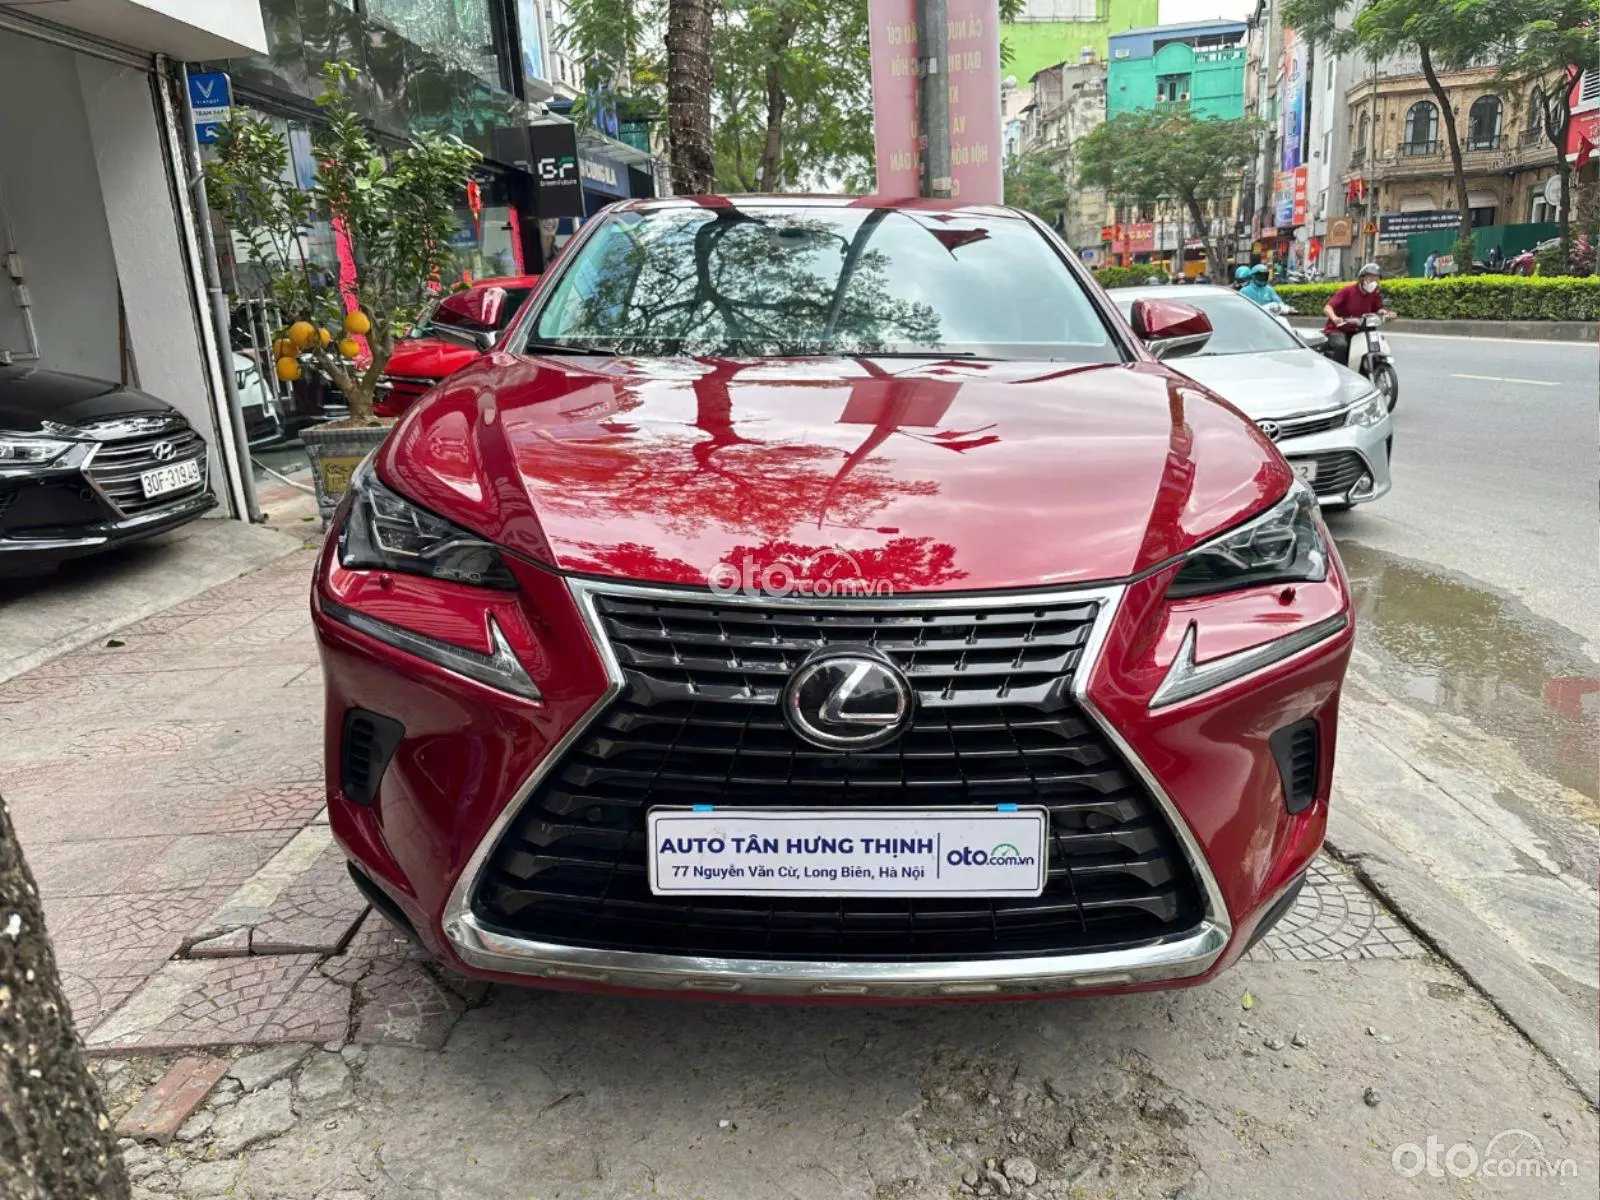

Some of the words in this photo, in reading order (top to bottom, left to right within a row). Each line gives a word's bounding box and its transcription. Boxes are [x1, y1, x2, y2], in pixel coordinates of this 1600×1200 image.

[659, 838, 725, 853] AUTO
[731, 834, 779, 853] TÂN
[786, 836, 854, 854] HƯNG
[861, 838, 933, 858] THỊNH
[947, 847, 1034, 866] oto.com.vn
[672, 866, 689, 877] 77
[693, 864, 744, 879] Nguyễn
[749, 866, 774, 877] Văn
[778, 866, 800, 880] Cừ,
[804, 867, 837, 880] Long
[841, 866, 875, 880] Biên,
[879, 866, 897, 878] Hà
[902, 866, 925, 880] Nội
